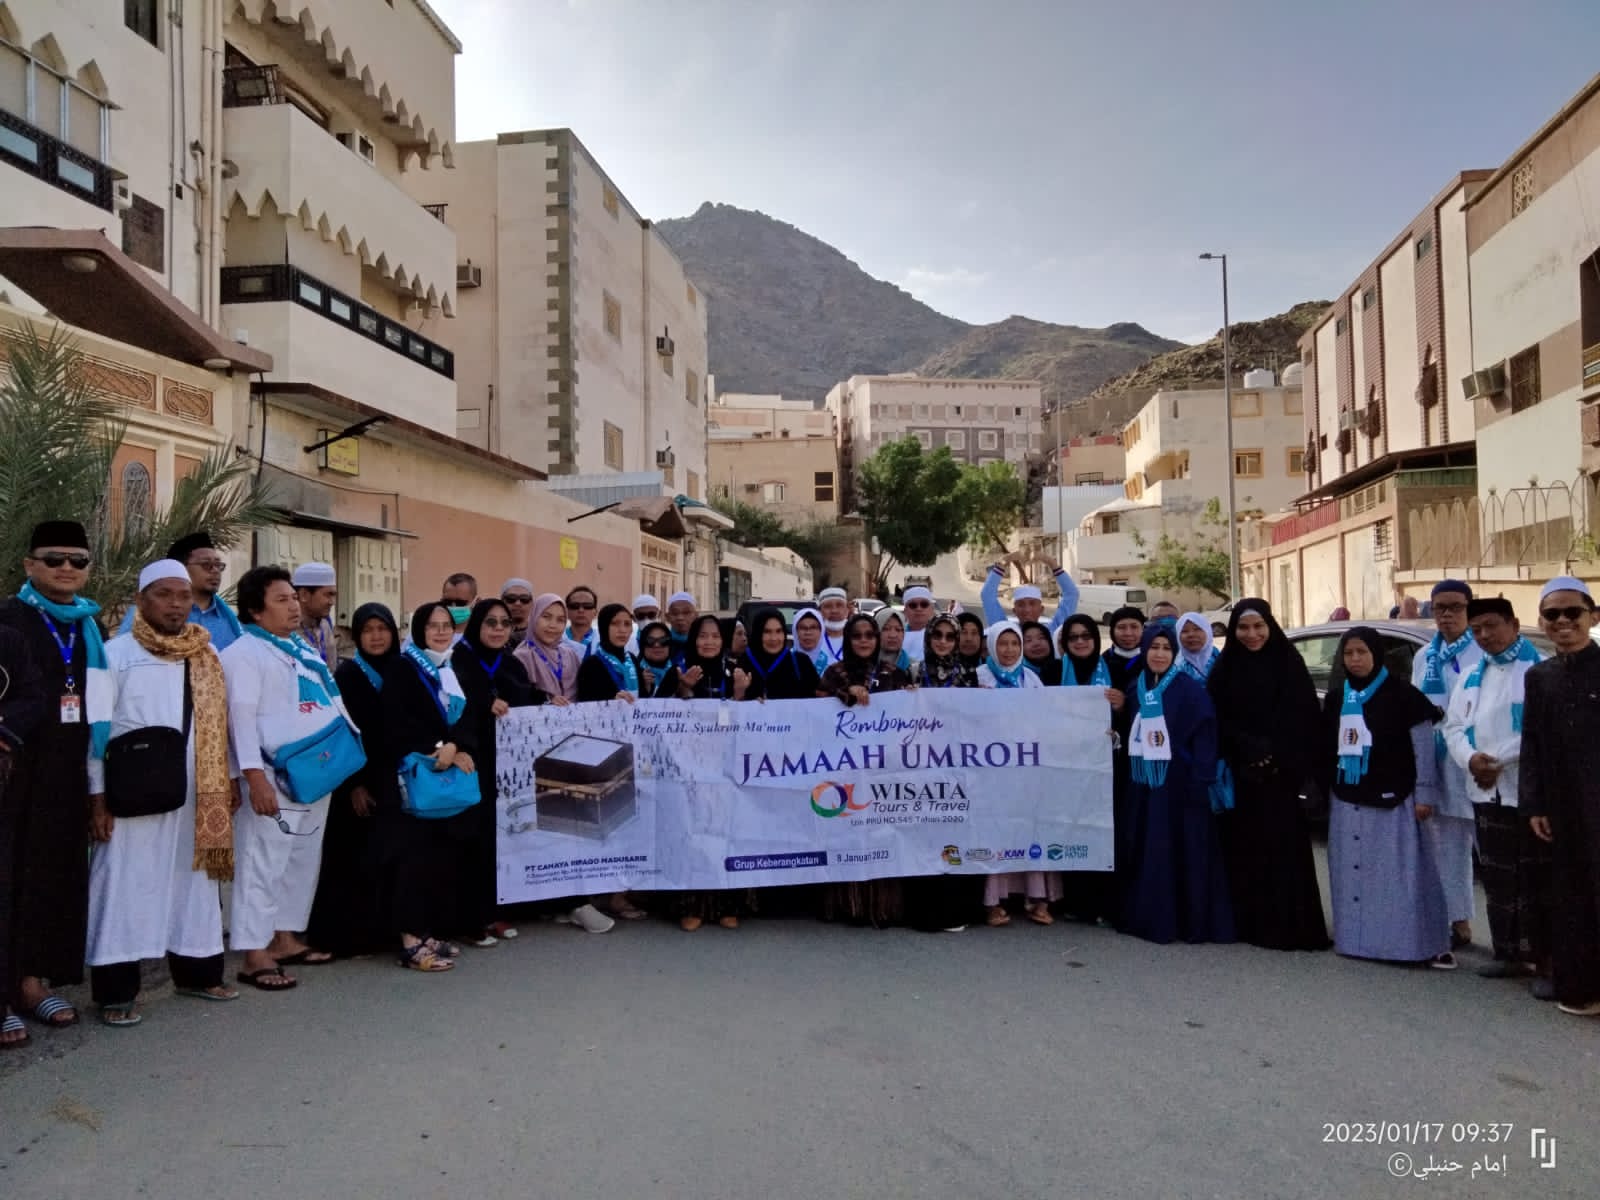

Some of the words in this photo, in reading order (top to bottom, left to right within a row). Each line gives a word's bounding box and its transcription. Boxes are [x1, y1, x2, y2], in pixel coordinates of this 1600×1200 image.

[632, 708, 682, 719] Bersama
[632, 723, 661, 736] Prof.
[666, 722, 688, 734] KH.
[744, 721, 791, 733] Ma'mun
[835, 709, 944, 744] Rombongan
[741, 744, 886, 785] JAMAAH
[901, 741, 1040, 769] UMROH
[870, 782, 968, 800] WISATA
[873, 801, 908, 813] Tours
[912, 800, 922, 812] &
[928, 799, 970, 812] Travel
[734, 859, 755, 870] Grup
[757, 855, 819, 869] Keberangkatan
[844, 851, 871, 863] Januari
